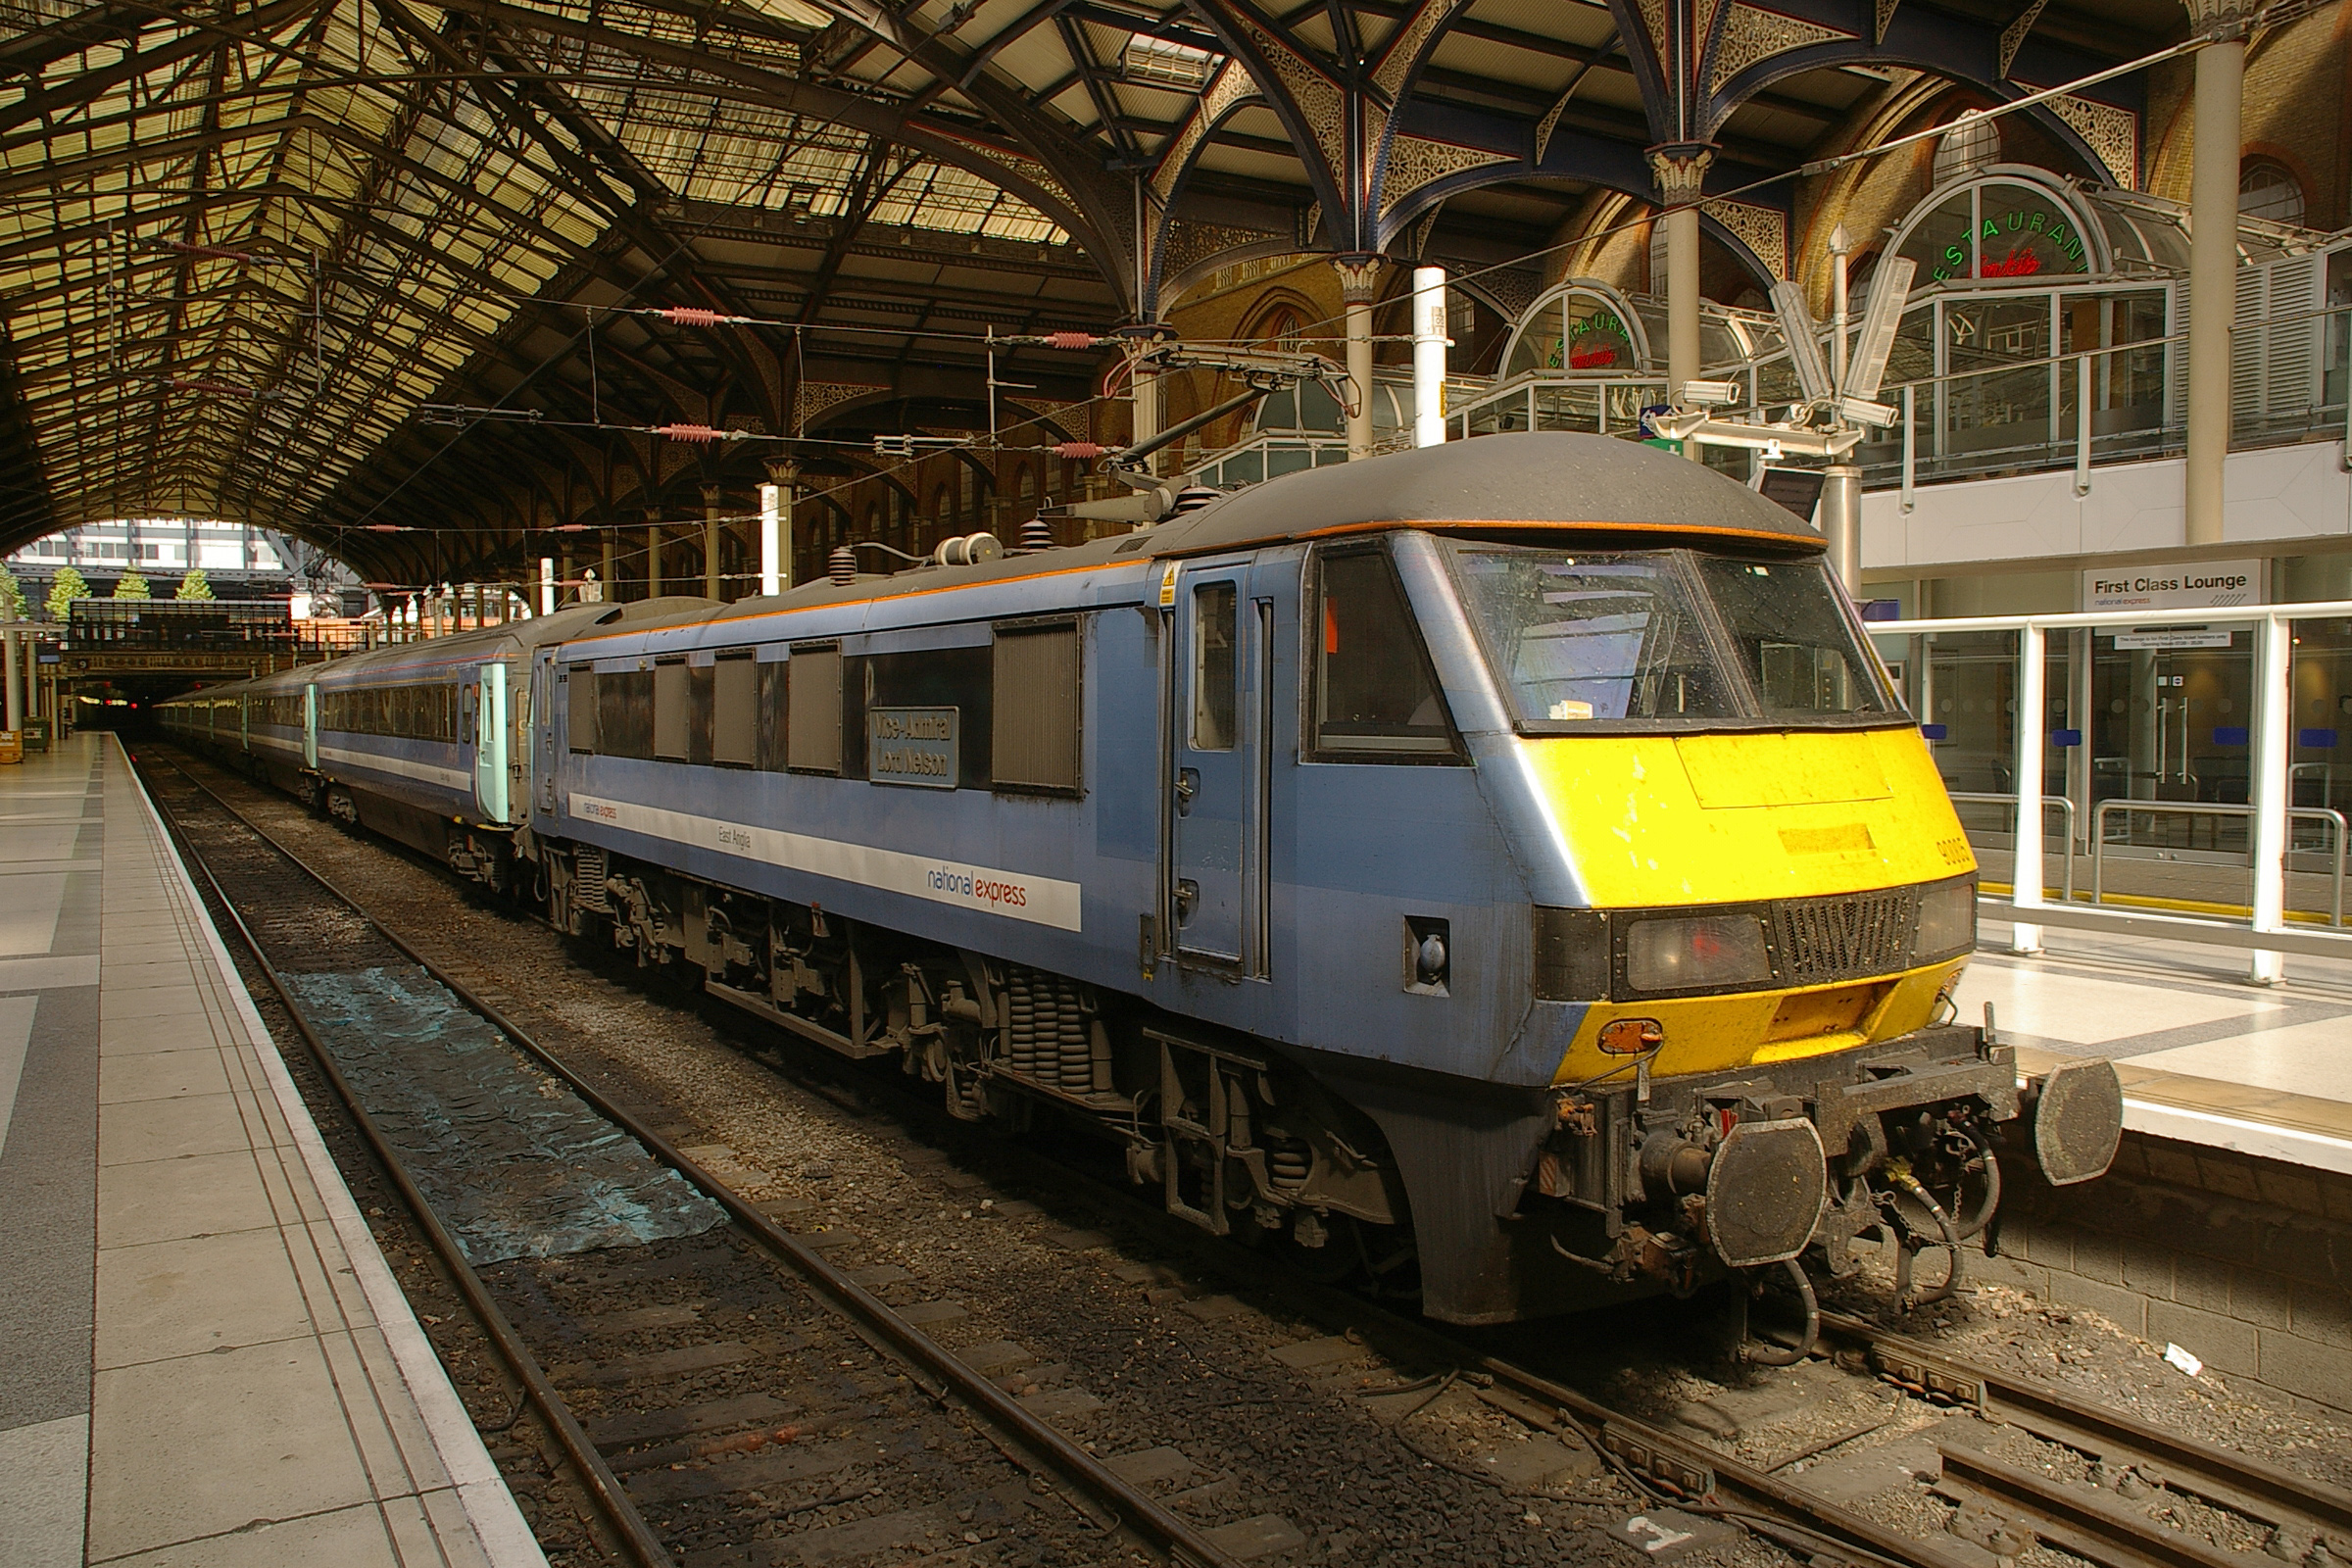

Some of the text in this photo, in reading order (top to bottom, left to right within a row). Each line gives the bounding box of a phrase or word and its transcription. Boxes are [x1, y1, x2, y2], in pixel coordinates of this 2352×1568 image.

[2094, 575, 2247, 594] First Class Lounge
[874, 711, 952, 741] Vice-Admiral
[877, 746, 948, 777] Lord Nelson
[718, 825, 751, 852] East Anglia
